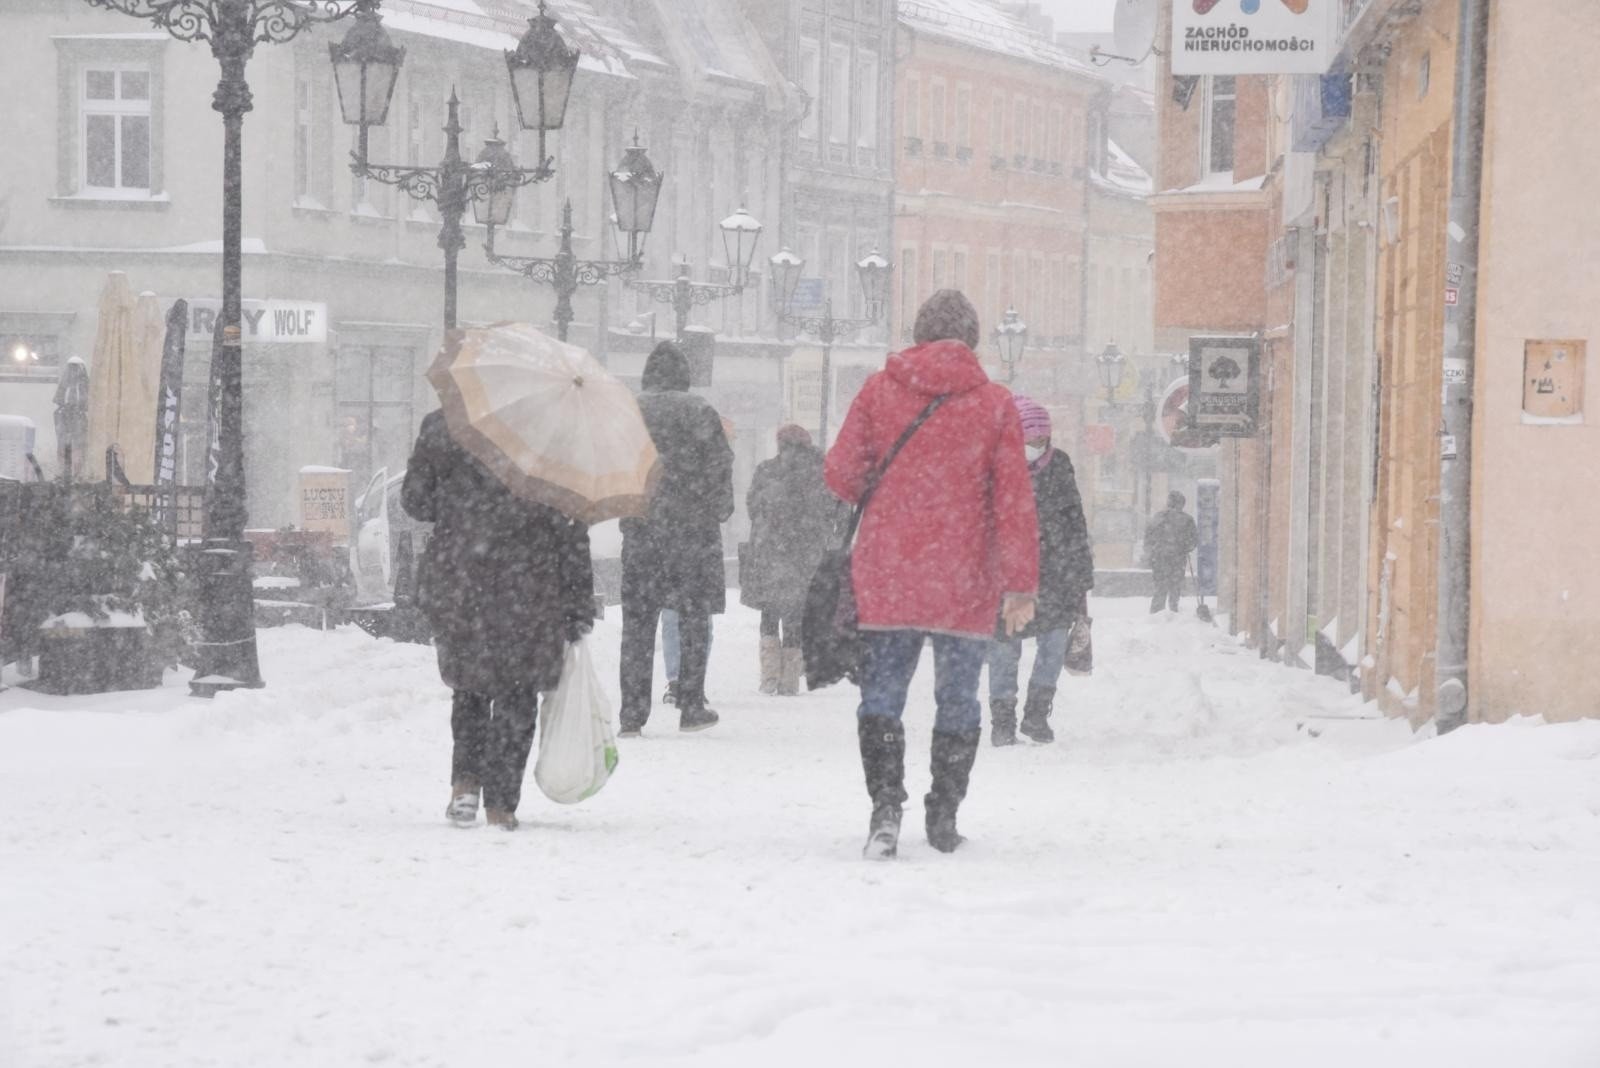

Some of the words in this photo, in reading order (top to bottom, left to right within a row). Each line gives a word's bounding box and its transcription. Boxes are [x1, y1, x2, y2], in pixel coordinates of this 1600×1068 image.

[1185, 23, 1249, 39] ZACHÓD
[1184, 37, 1314, 52] NIERUCHOMOŚCI
[166, 306, 266, 335] RY
[274, 309, 315, 337] WOLF
